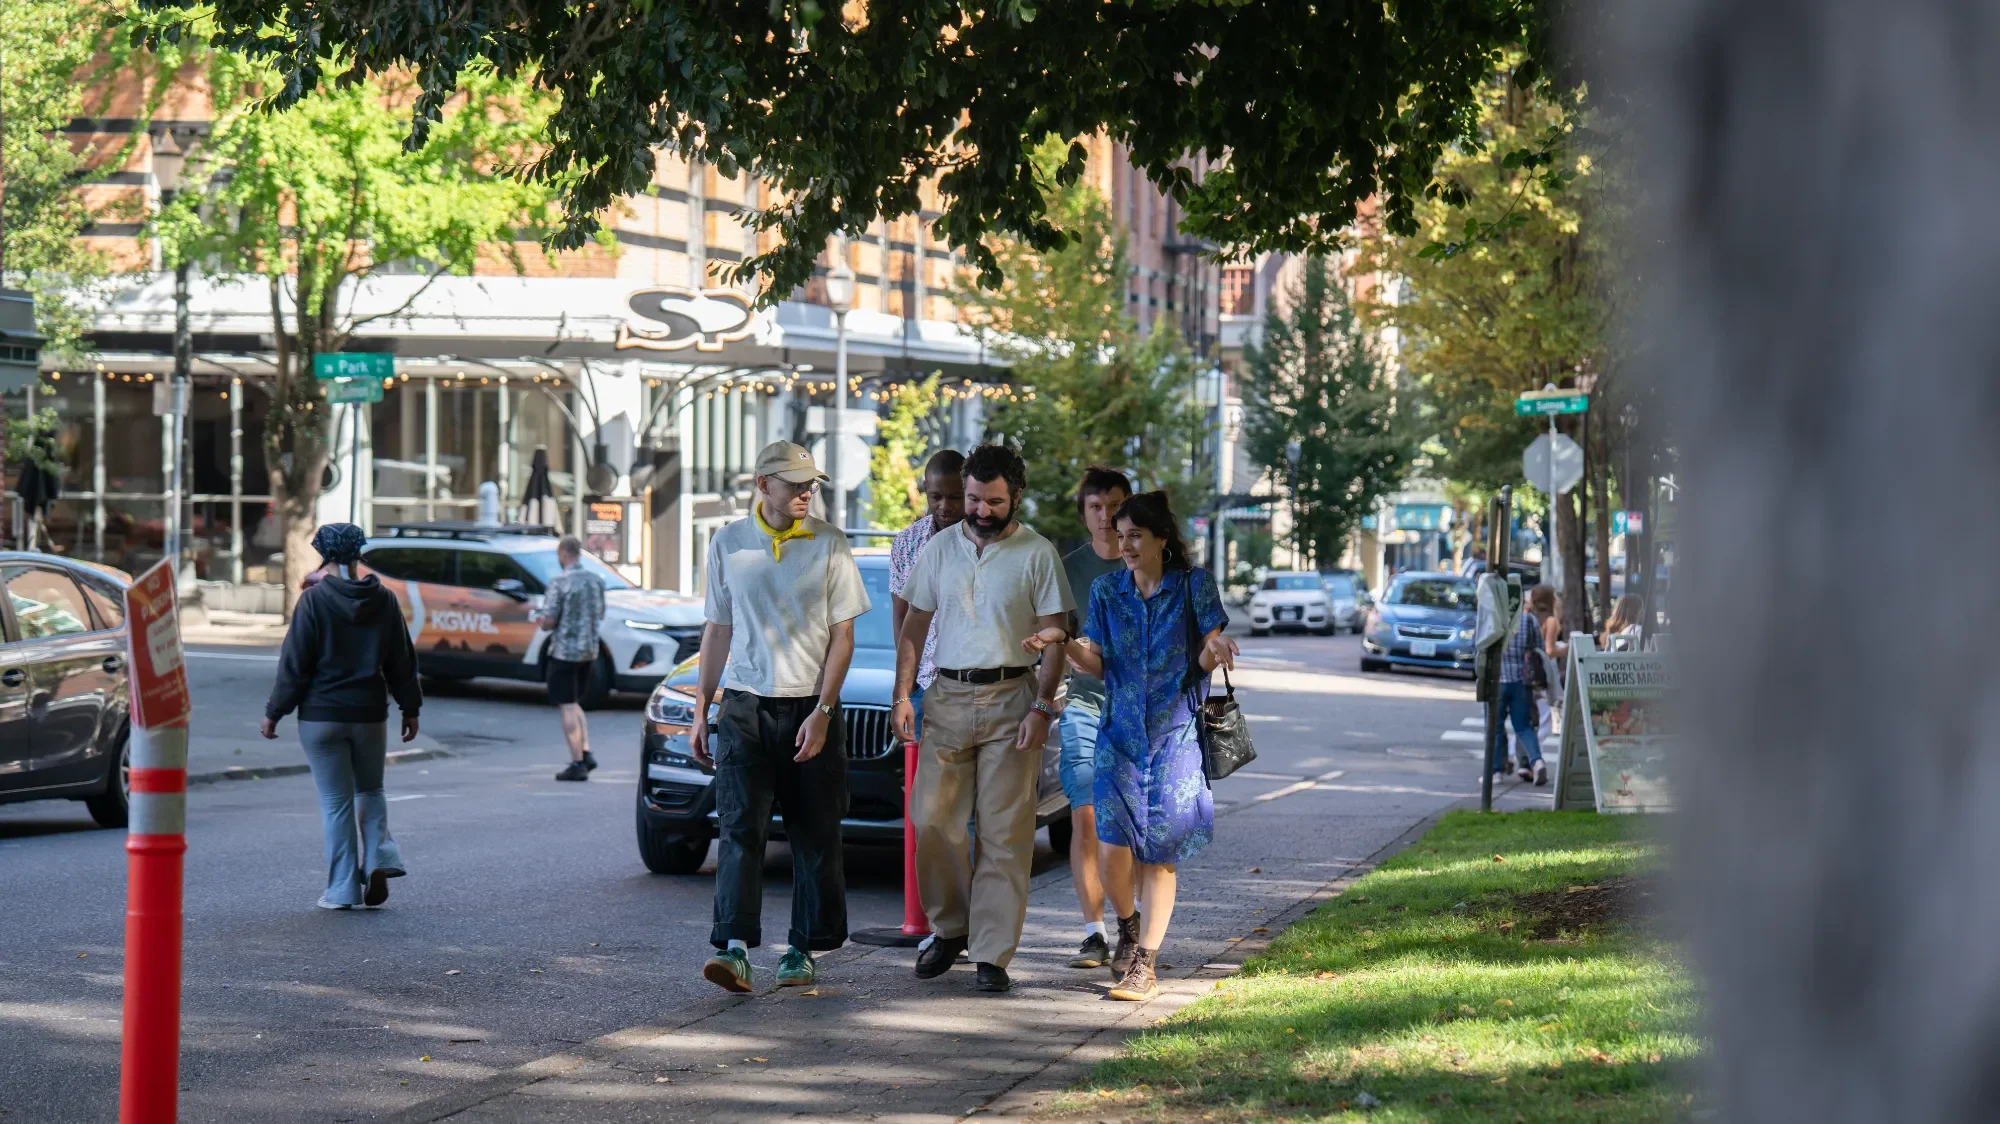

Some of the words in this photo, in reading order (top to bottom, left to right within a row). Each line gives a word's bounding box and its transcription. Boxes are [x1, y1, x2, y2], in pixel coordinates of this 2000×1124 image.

[338, 360, 369, 374] Park
[1536, 400, 1566, 412] Salmon
[1604, 662, 1661, 671] PORTLAND
[1589, 672, 1635, 685] FARMERS
